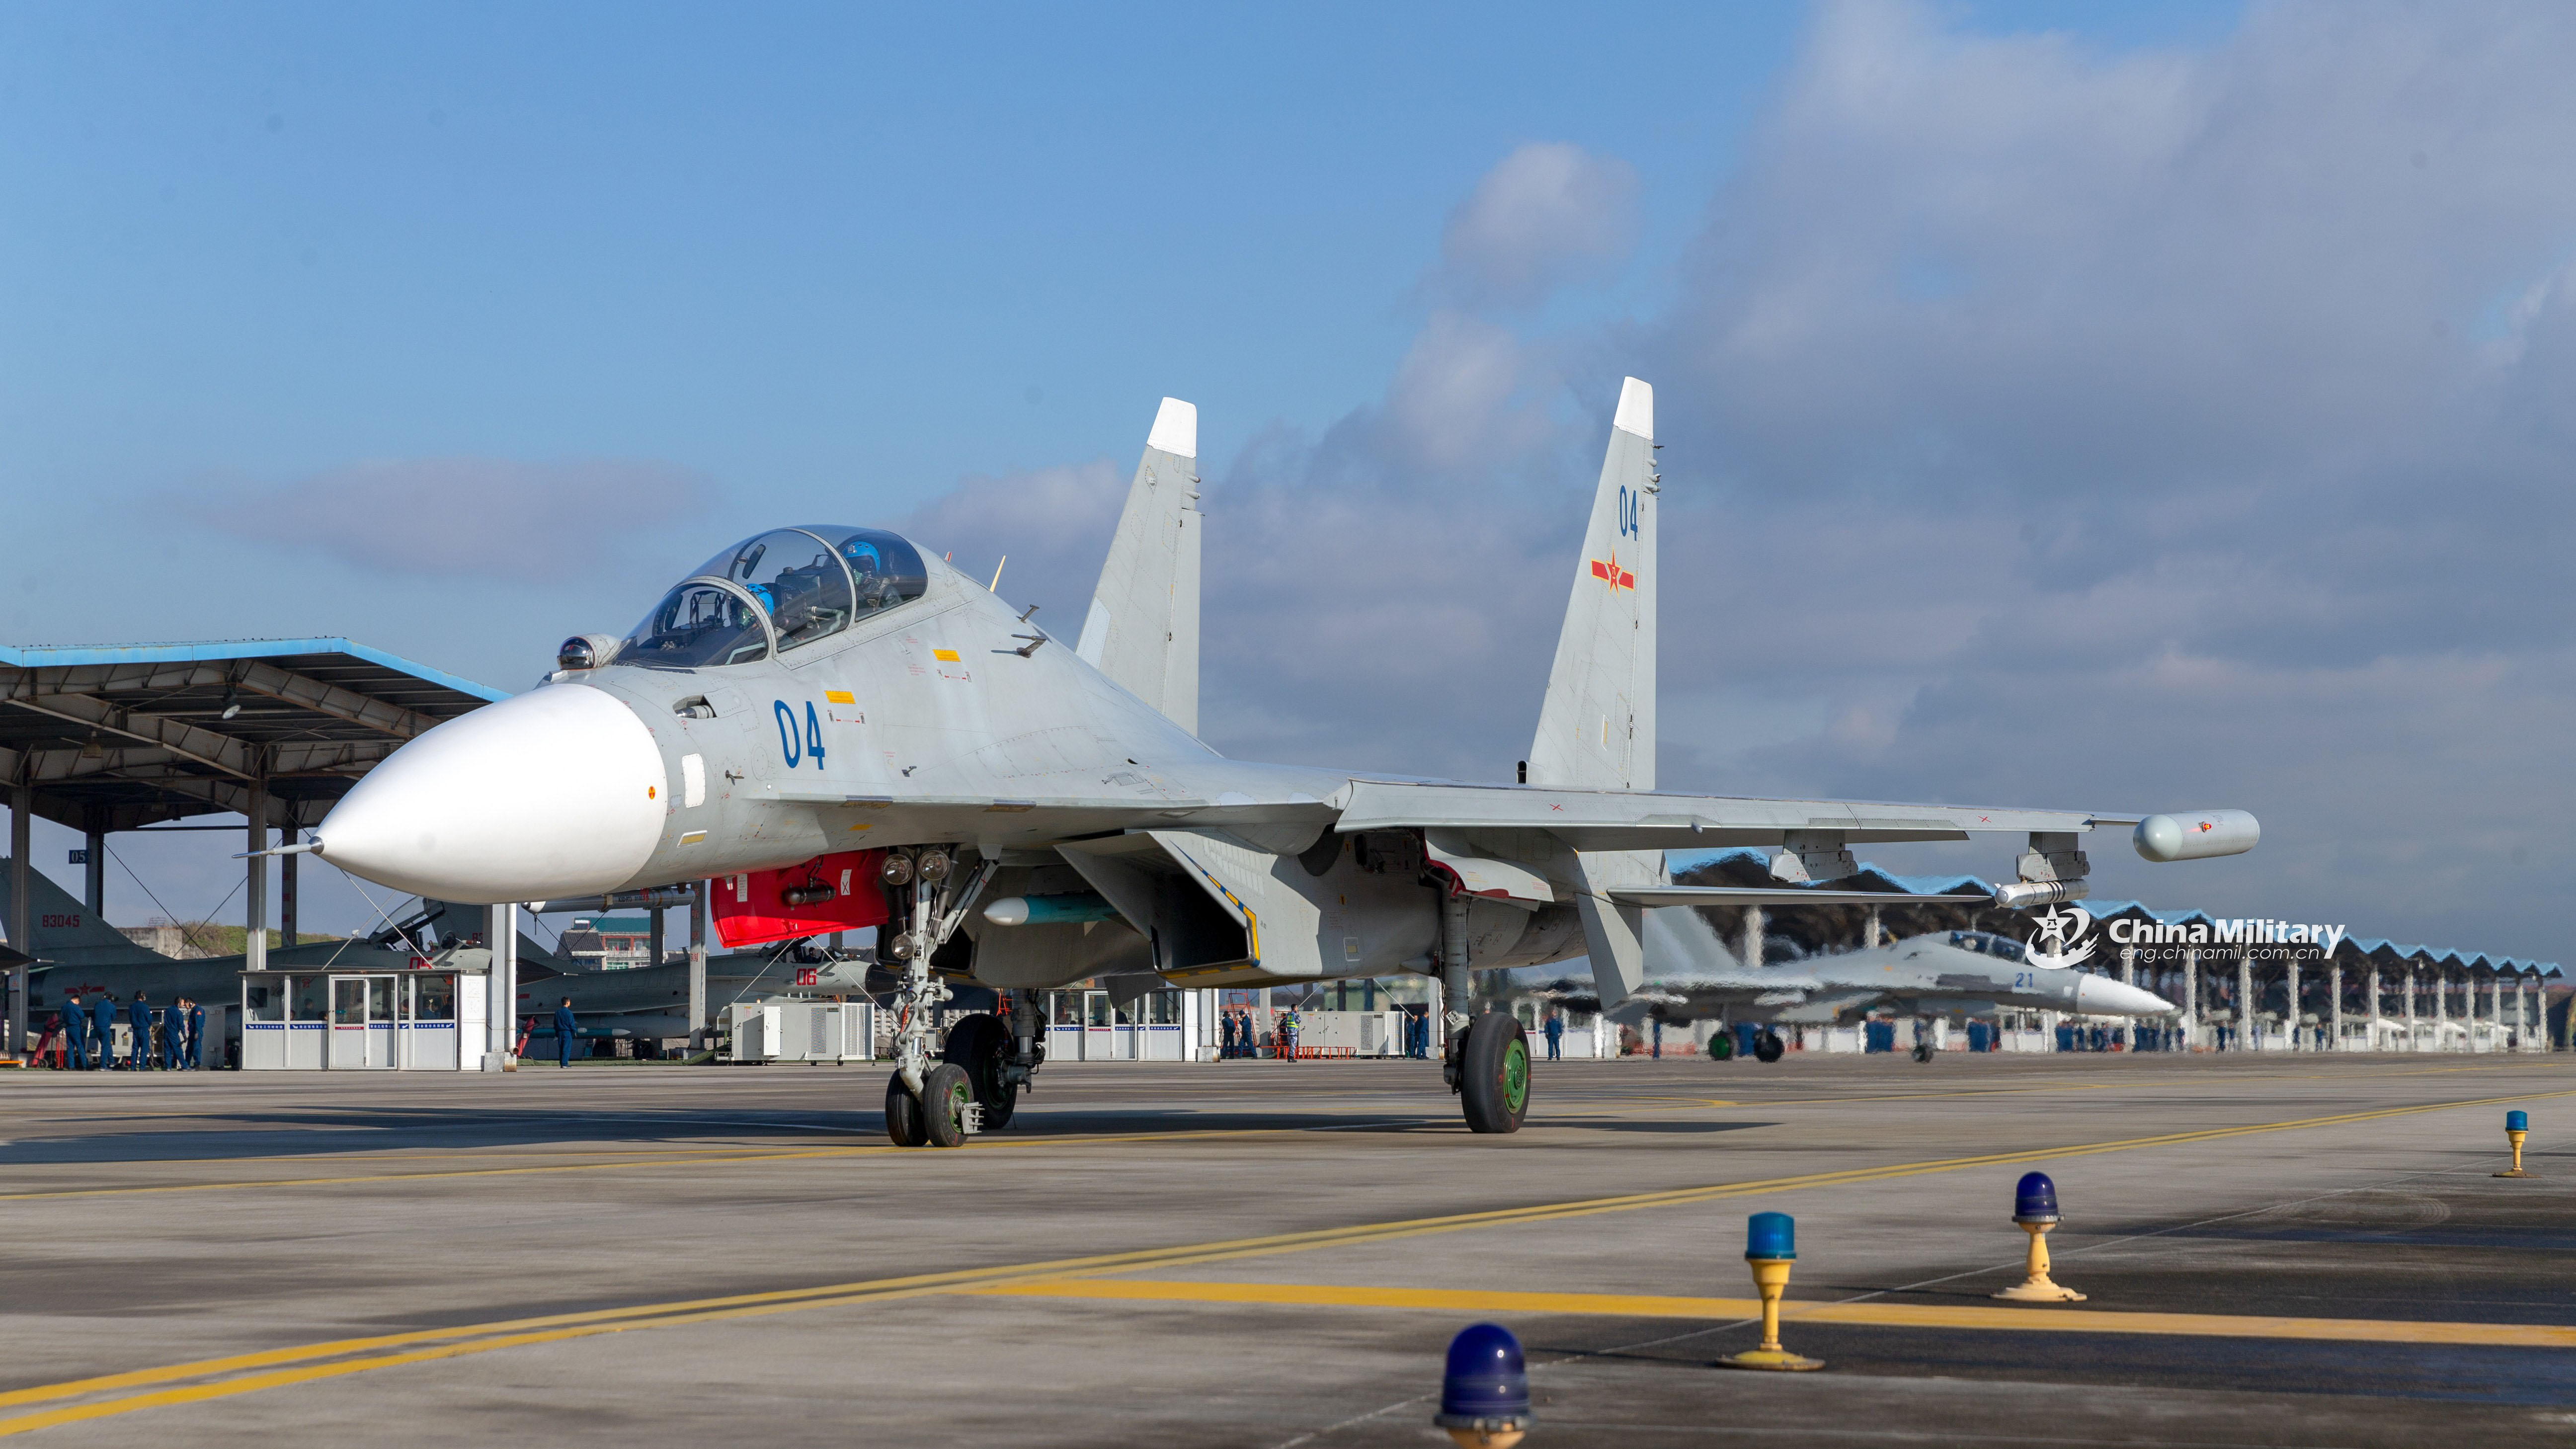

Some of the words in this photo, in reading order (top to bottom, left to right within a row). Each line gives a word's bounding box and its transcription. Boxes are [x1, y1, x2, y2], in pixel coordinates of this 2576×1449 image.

[1619, 485, 1638, 541] 04
[774, 699, 825, 770] 04
[72, 851, 85, 862] 05
[42, 915, 80, 927] 83045
[409, 957, 433, 969] 05
[797, 968, 817, 985] 06
[2015, 972, 2033, 987] 21
